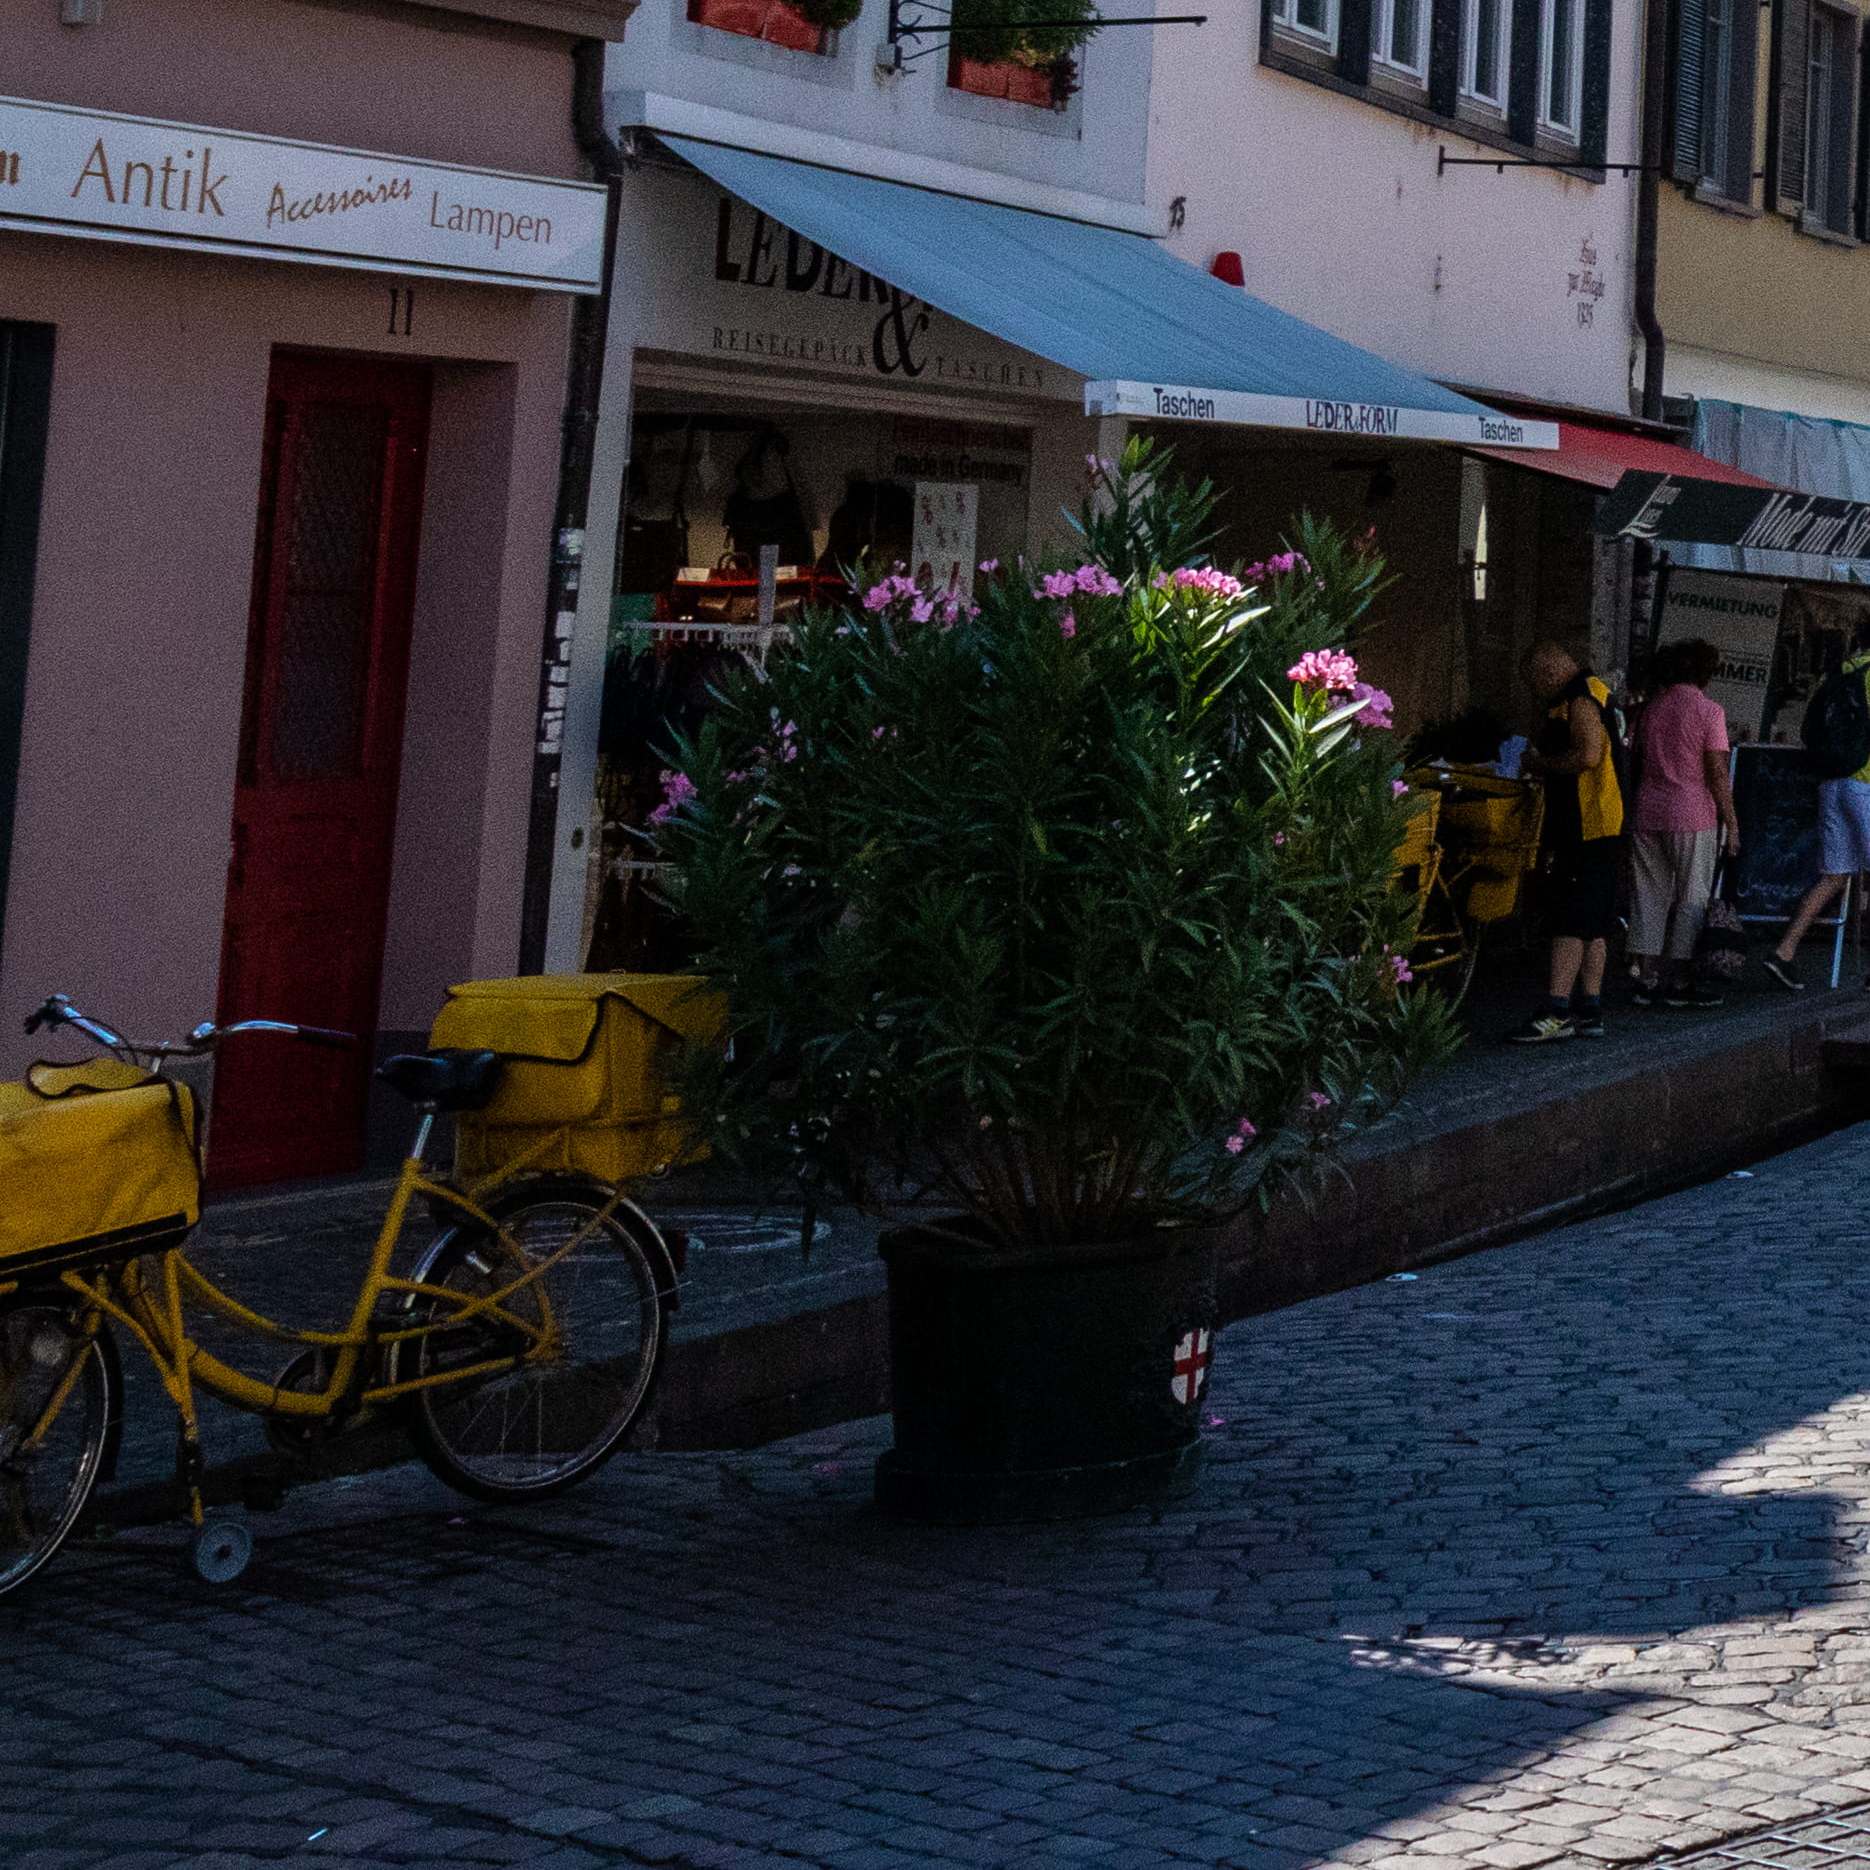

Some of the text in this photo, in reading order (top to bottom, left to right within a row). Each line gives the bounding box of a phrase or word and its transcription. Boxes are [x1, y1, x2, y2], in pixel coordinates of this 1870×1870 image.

[70, 137, 230, 217] Antik
[267, 175, 413, 229] Accessoires
[429, 191, 552, 250] Lampen
[1153, 388, 1216, 420] Taschen
[1478, 417, 1524, 444] Taschen
[1667, 591, 1780, 619] VERMIETUNG
